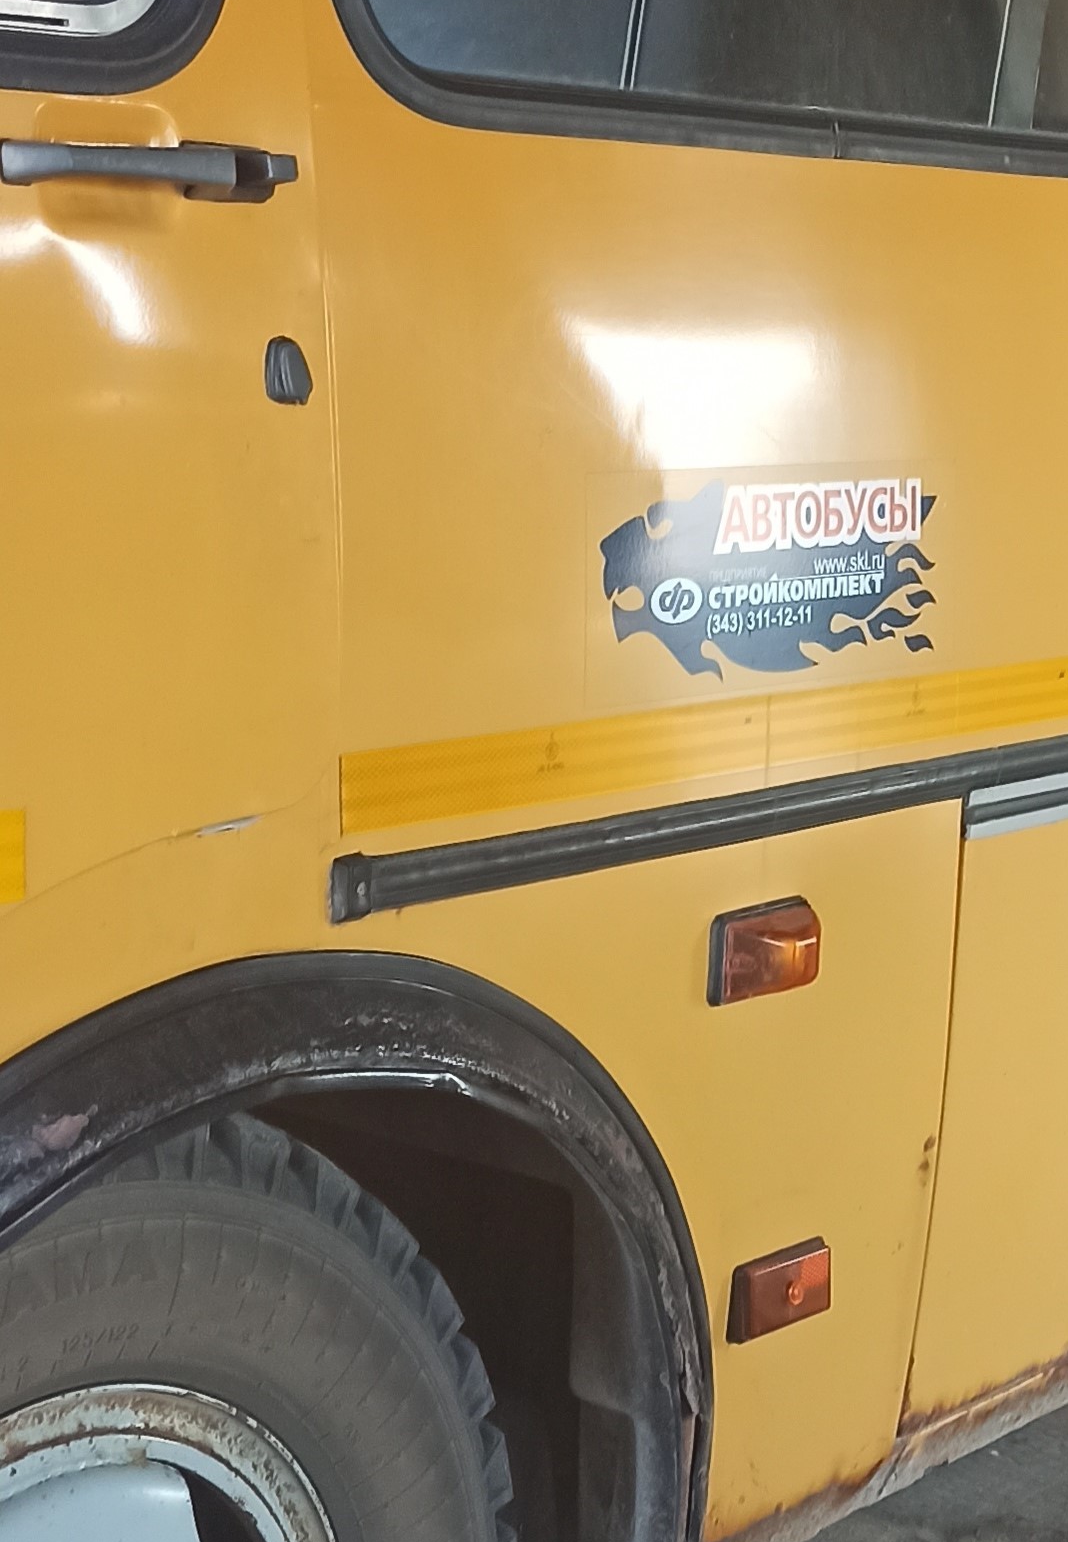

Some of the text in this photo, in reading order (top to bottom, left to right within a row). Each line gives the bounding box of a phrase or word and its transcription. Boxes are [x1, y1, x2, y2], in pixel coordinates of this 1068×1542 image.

[718, 483, 919, 547] АВТОБУСЫ
[813, 550, 886, 574] www.skl.ru
[708, 573, 885, 609] СТРОЙКОМПЛЕКТ
[706, 605, 812, 639] (343) 311-12-11
